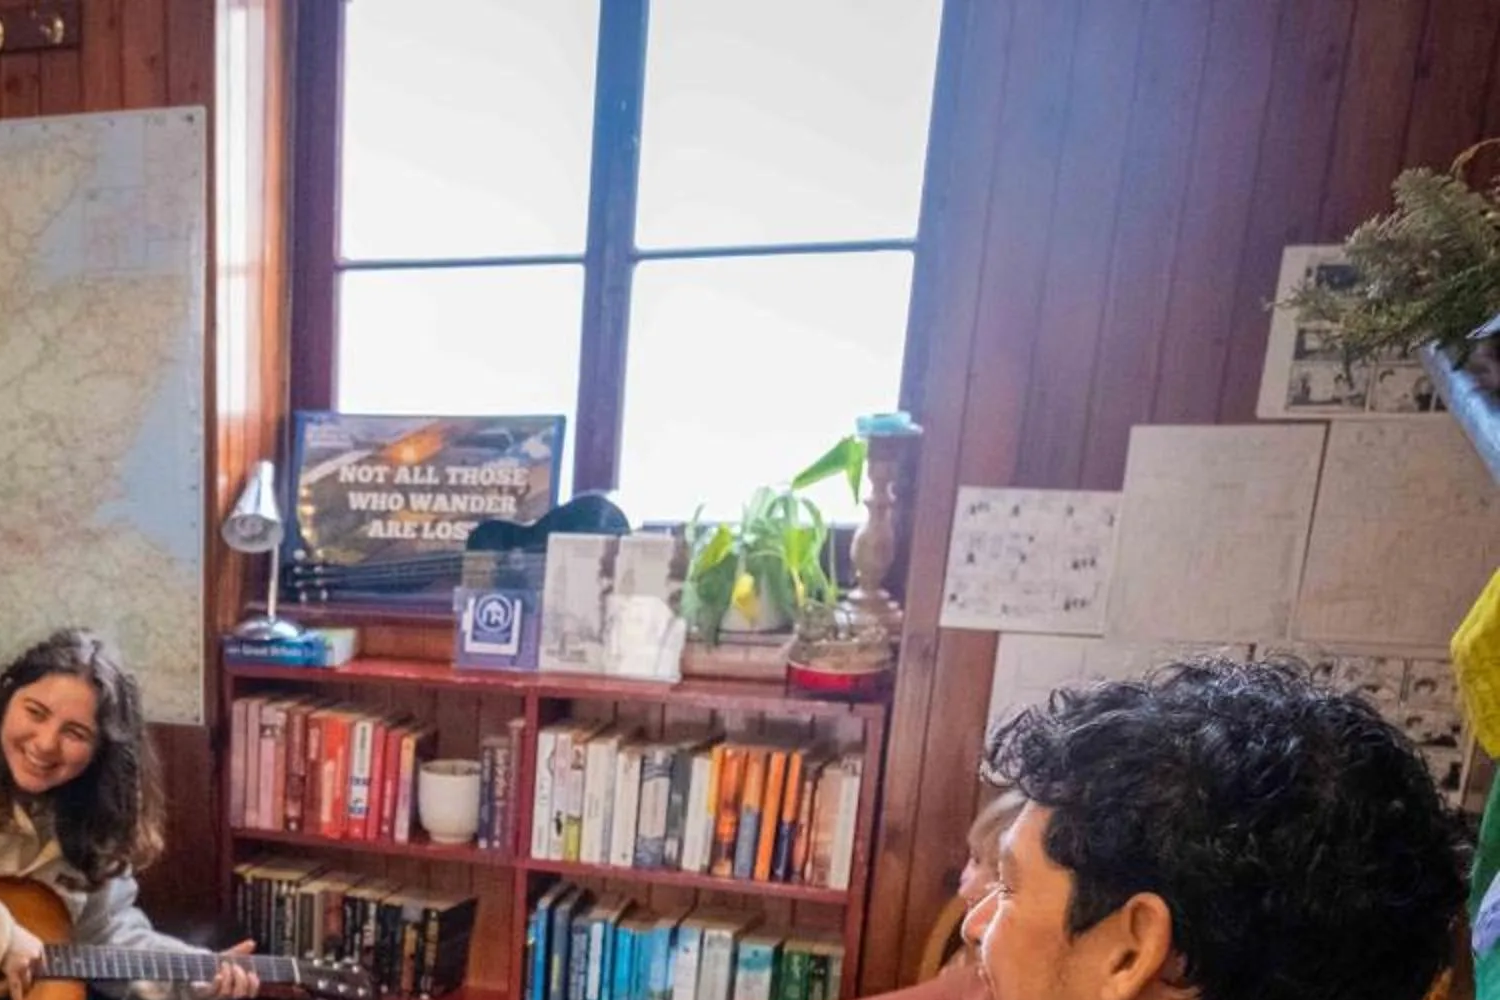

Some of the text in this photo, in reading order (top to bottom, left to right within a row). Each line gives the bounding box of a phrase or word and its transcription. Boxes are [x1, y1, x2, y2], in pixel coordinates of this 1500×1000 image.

[339, 465, 530, 486] NOT ALL THOSE
[348, 491, 517, 513] WHO WANDER
[367, 519, 417, 538] ARE
